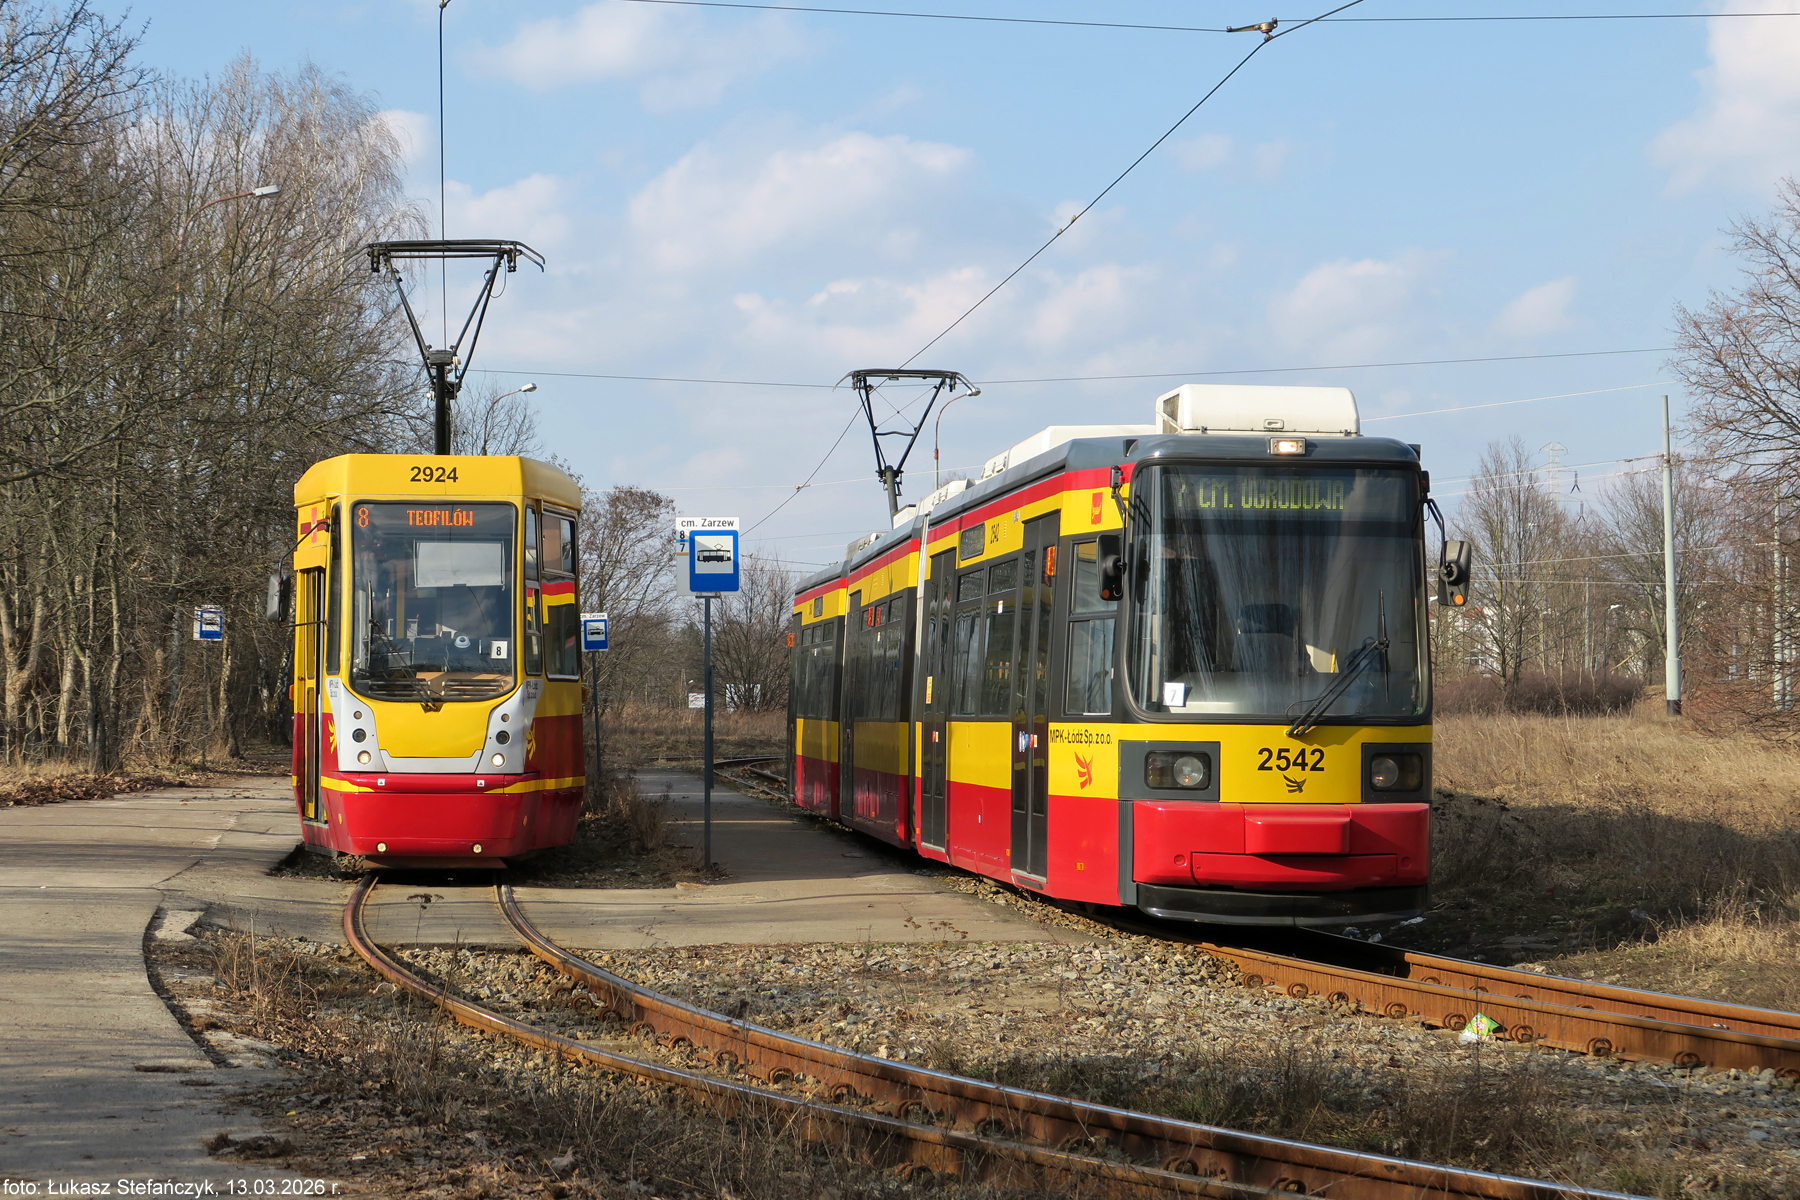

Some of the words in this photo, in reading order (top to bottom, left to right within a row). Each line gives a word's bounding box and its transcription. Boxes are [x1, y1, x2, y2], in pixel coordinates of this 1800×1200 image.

[410, 466, 458, 483] 2924
[357, 507, 369, 528] 8
[407, 508, 473, 527] TEOFILÓW
[680, 519, 698, 528] cm.
[701, 517, 735, 528] Zarzew
[679, 530, 685, 540] 8
[679, 543, 686, 553] 7
[496, 645, 502, 656] 8
[1170, 689, 1178, 703] 7
[1049, 728, 1083, 744] MPK-Łódź
[1084, 728, 1095, 748] Sp.
[1095, 733, 1100, 744] z
[1100, 733, 1113, 745] o.o.
[1257, 747, 1325, 772] 2542
